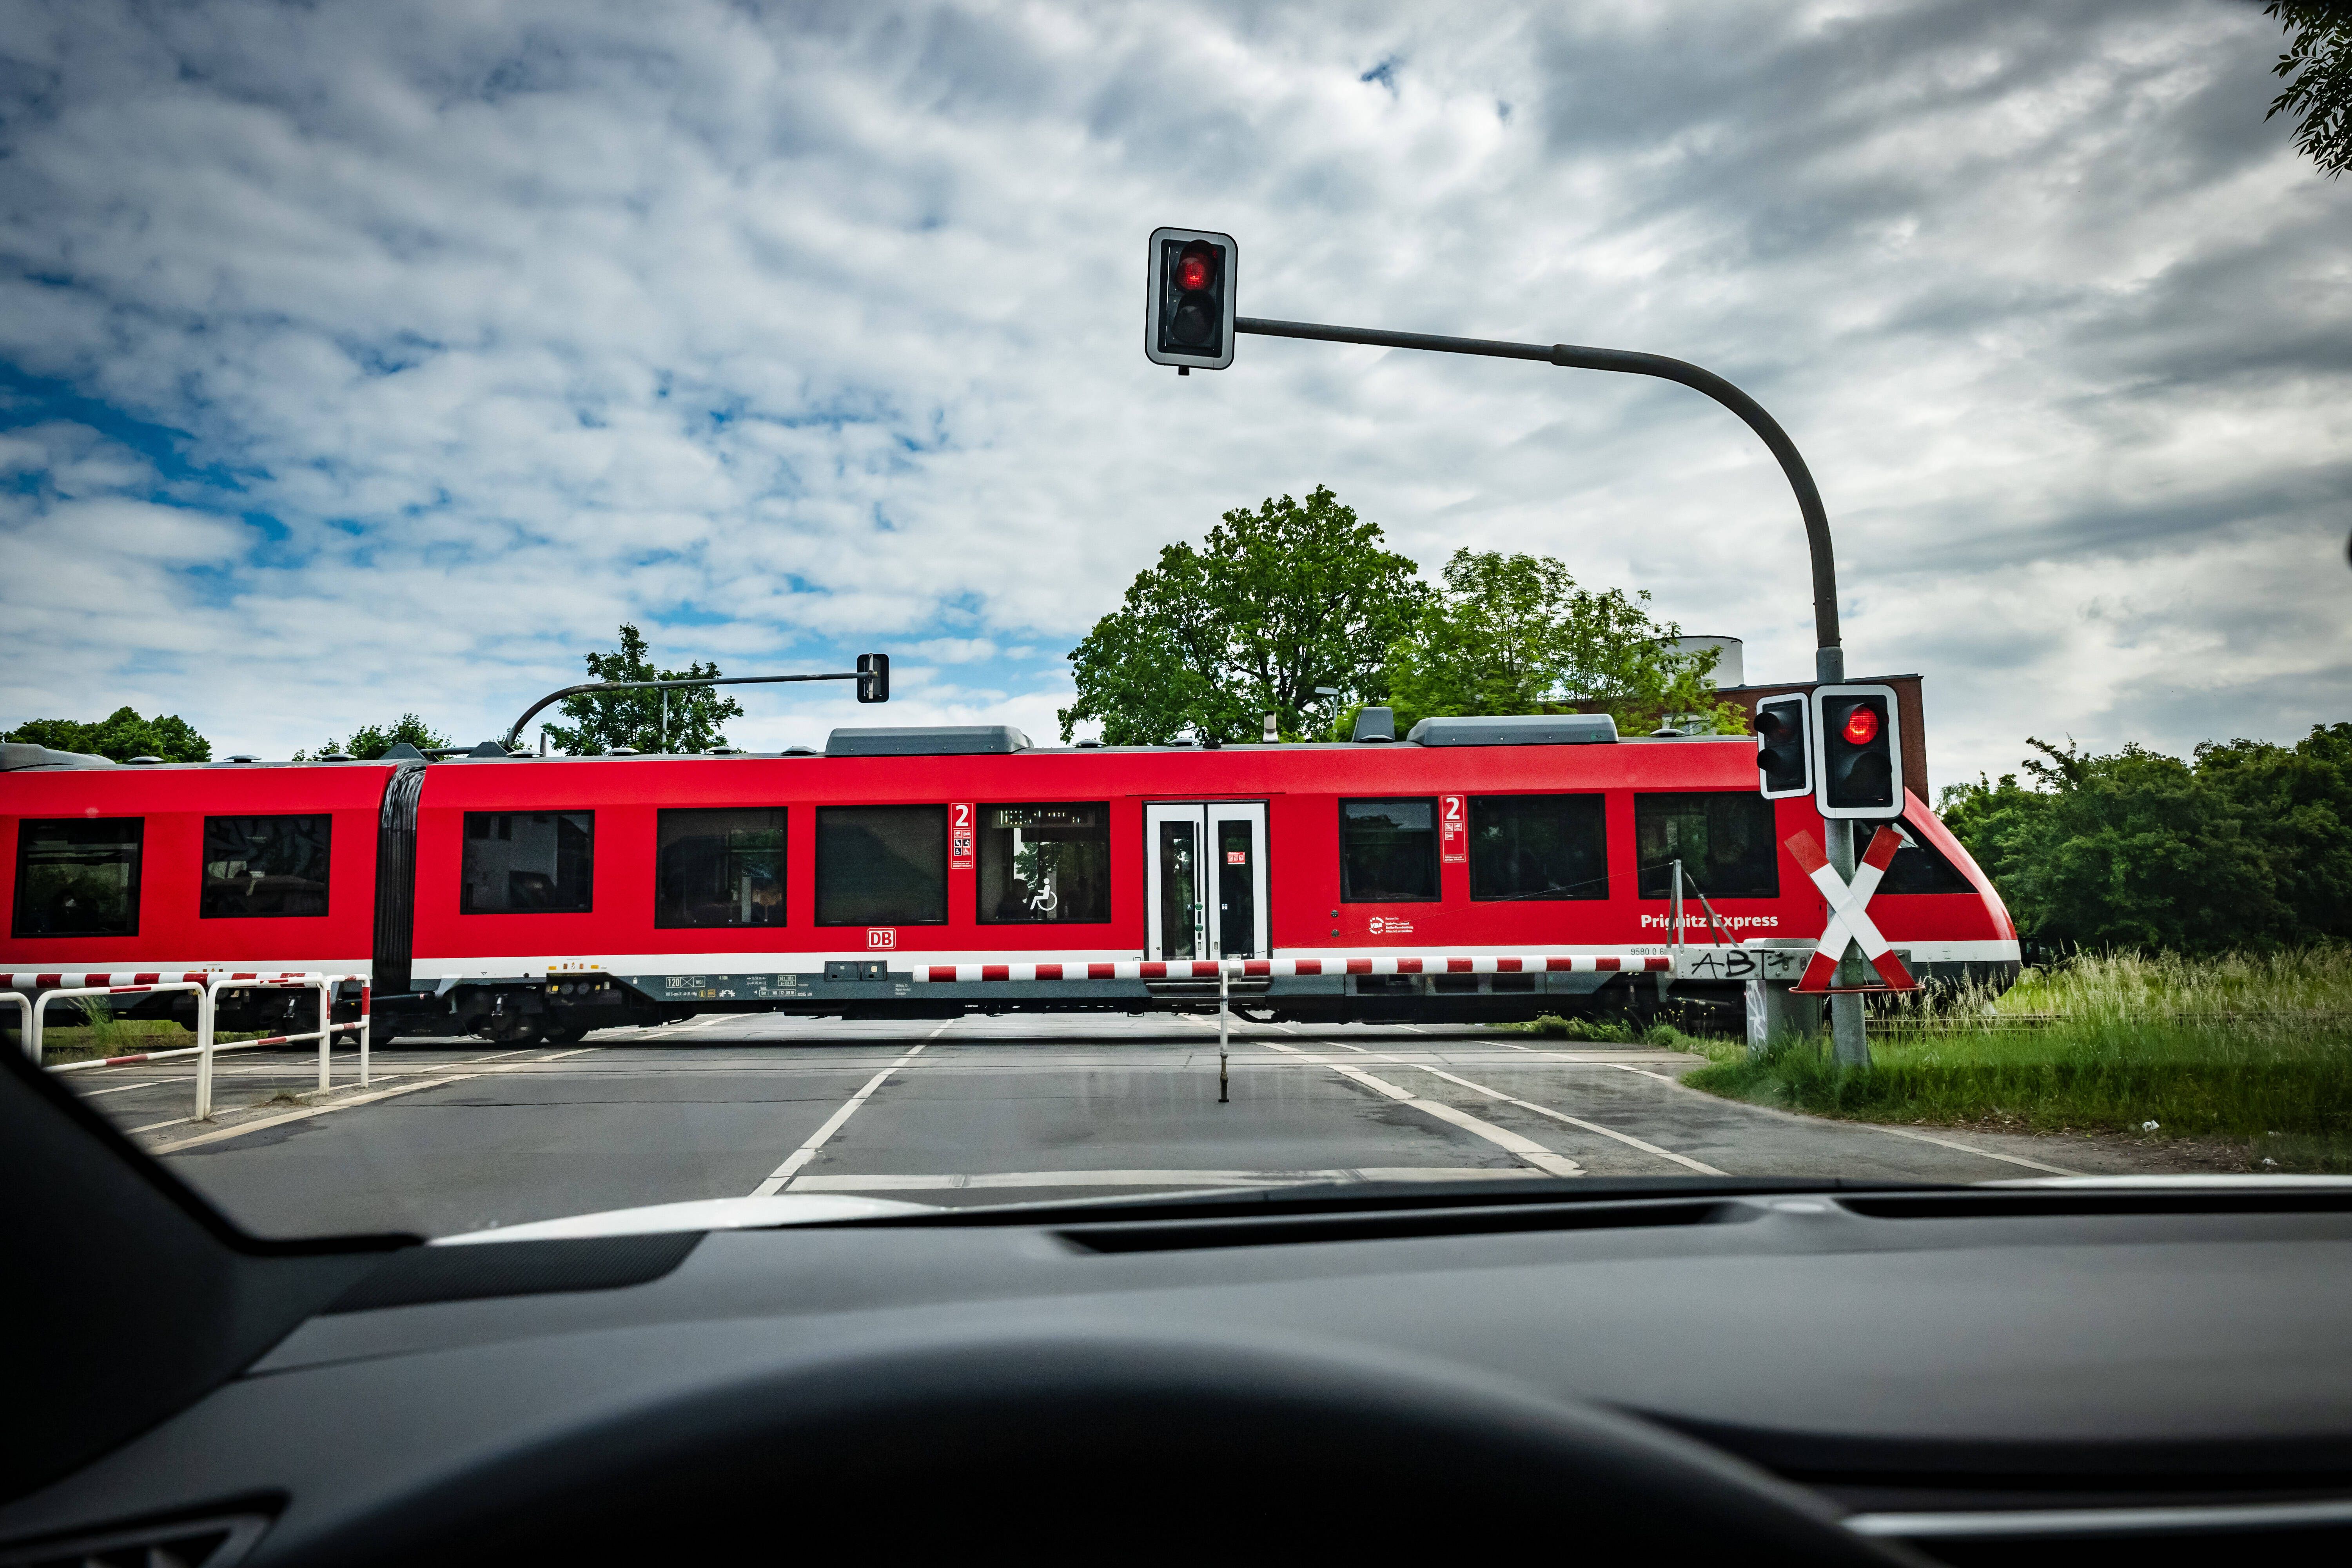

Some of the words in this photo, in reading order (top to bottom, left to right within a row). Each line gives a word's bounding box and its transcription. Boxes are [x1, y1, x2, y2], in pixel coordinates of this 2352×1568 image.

[955, 805, 968, 826] 2
[1446, 797, 1460, 820] 2
[1712, 914, 1778, 930] Express
[871, 932, 892, 946] DB
[668, 978, 680, 987] 120
